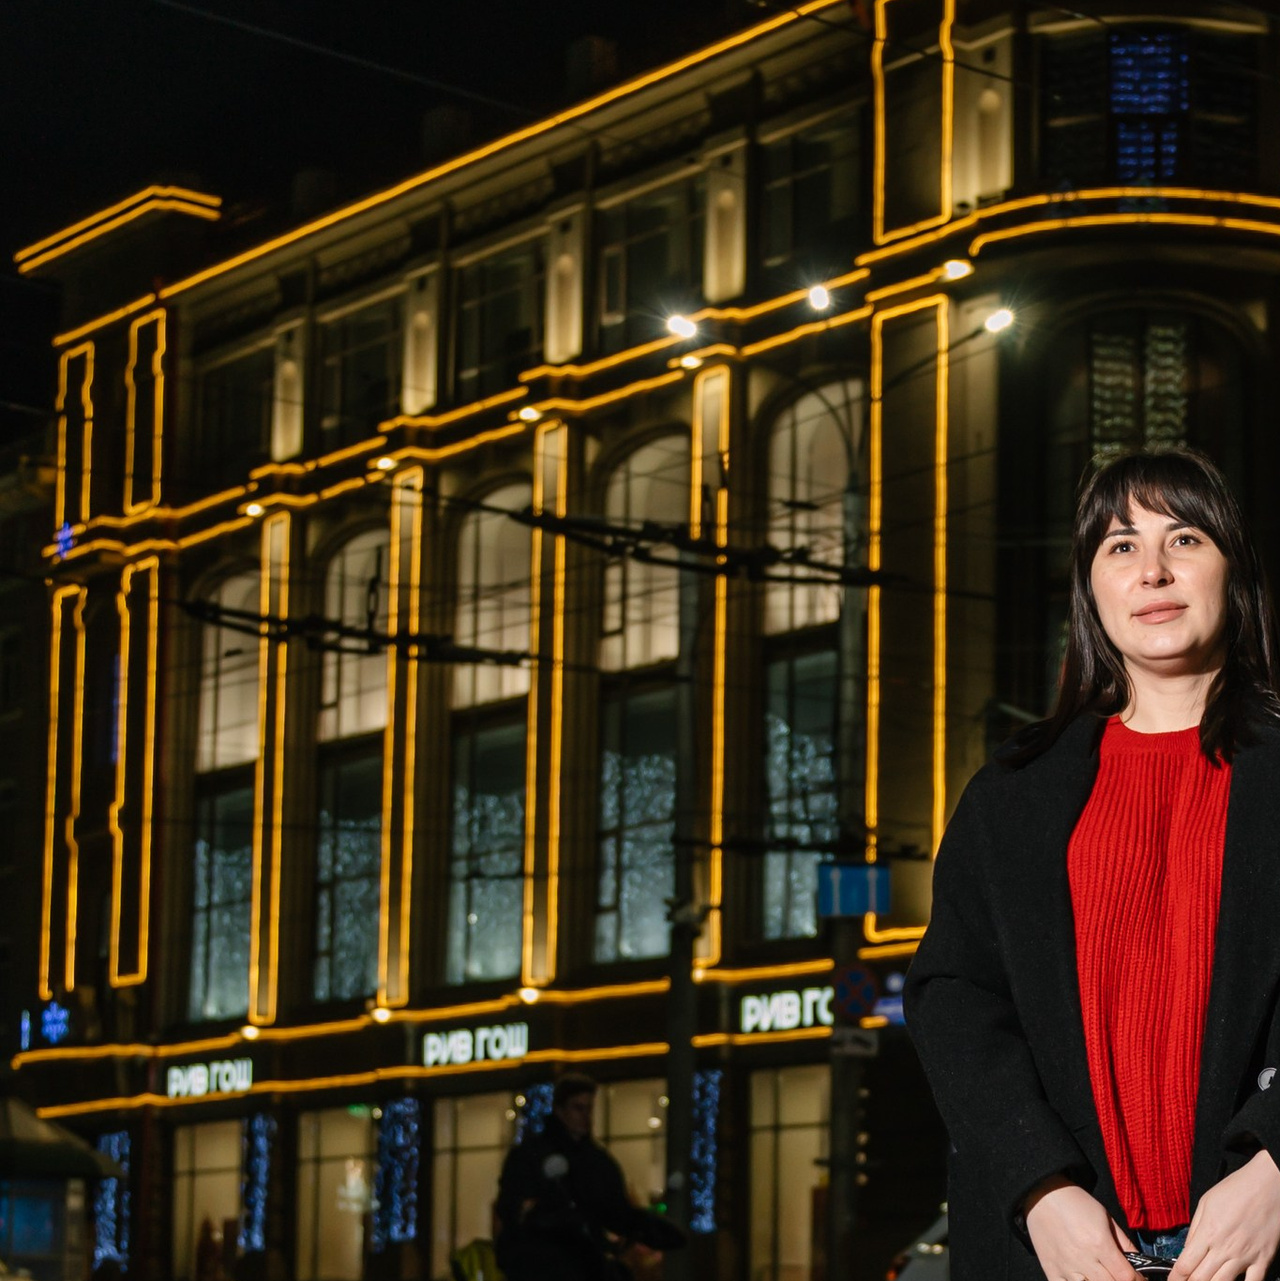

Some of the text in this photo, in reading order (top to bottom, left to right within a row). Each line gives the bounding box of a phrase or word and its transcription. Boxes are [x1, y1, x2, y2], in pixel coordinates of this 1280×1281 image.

[742, 986, 834, 1033] РИВ ГО
[423, 1022, 529, 1069] РИВ ГОШ
[167, 1057, 253, 1099] РИВ ГОШ
